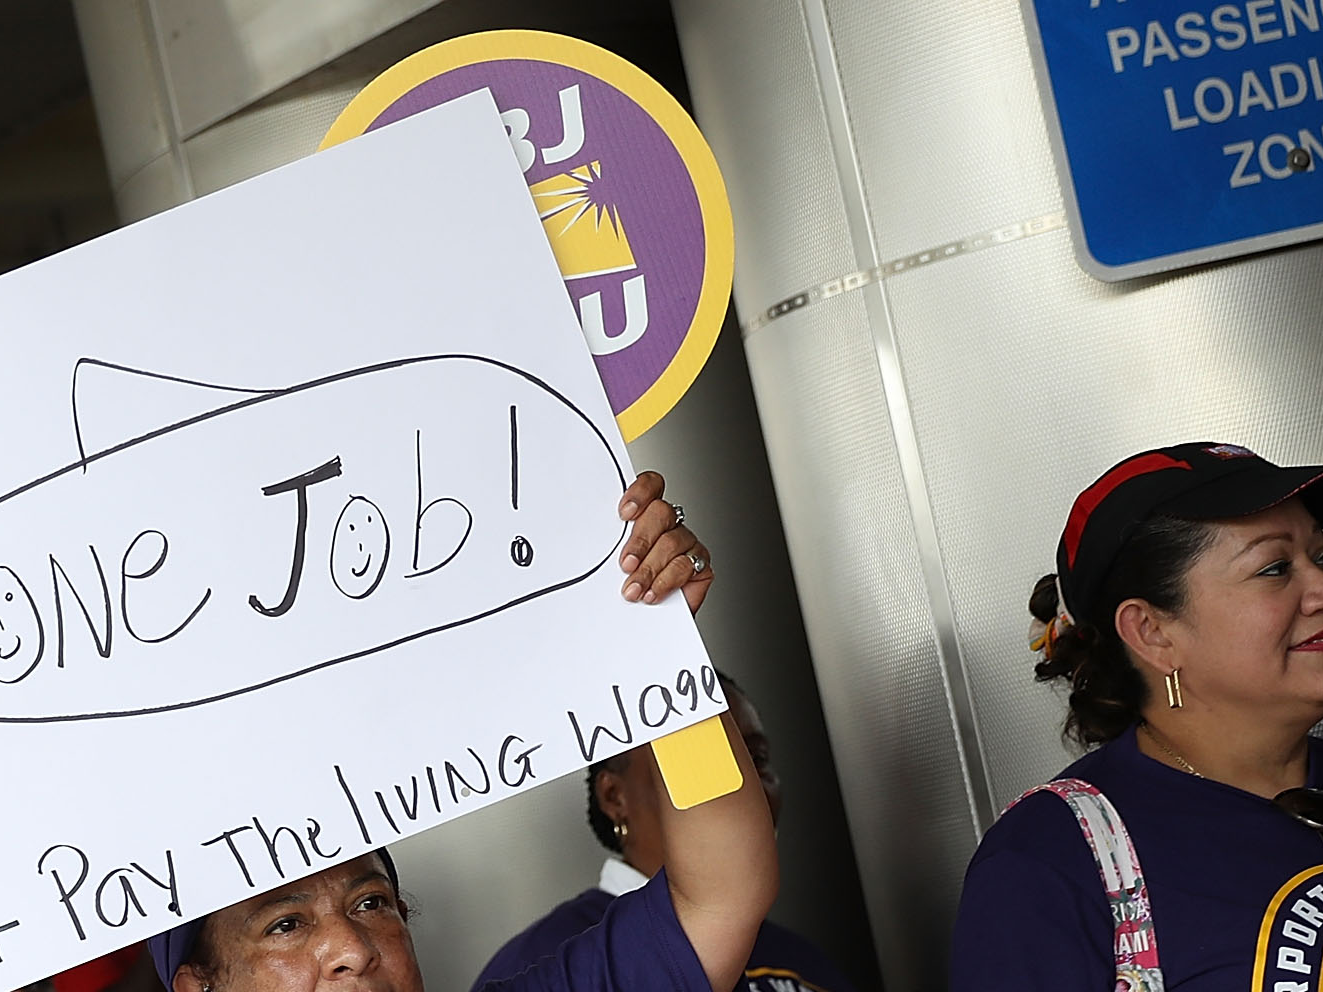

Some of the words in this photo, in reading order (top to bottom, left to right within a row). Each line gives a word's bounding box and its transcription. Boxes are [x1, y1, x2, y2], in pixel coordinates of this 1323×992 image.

[1106, 0, 1323, 73] PASSEN
[1163, 57, 1323, 131] LOADI
[201, 815, 343, 888] The
